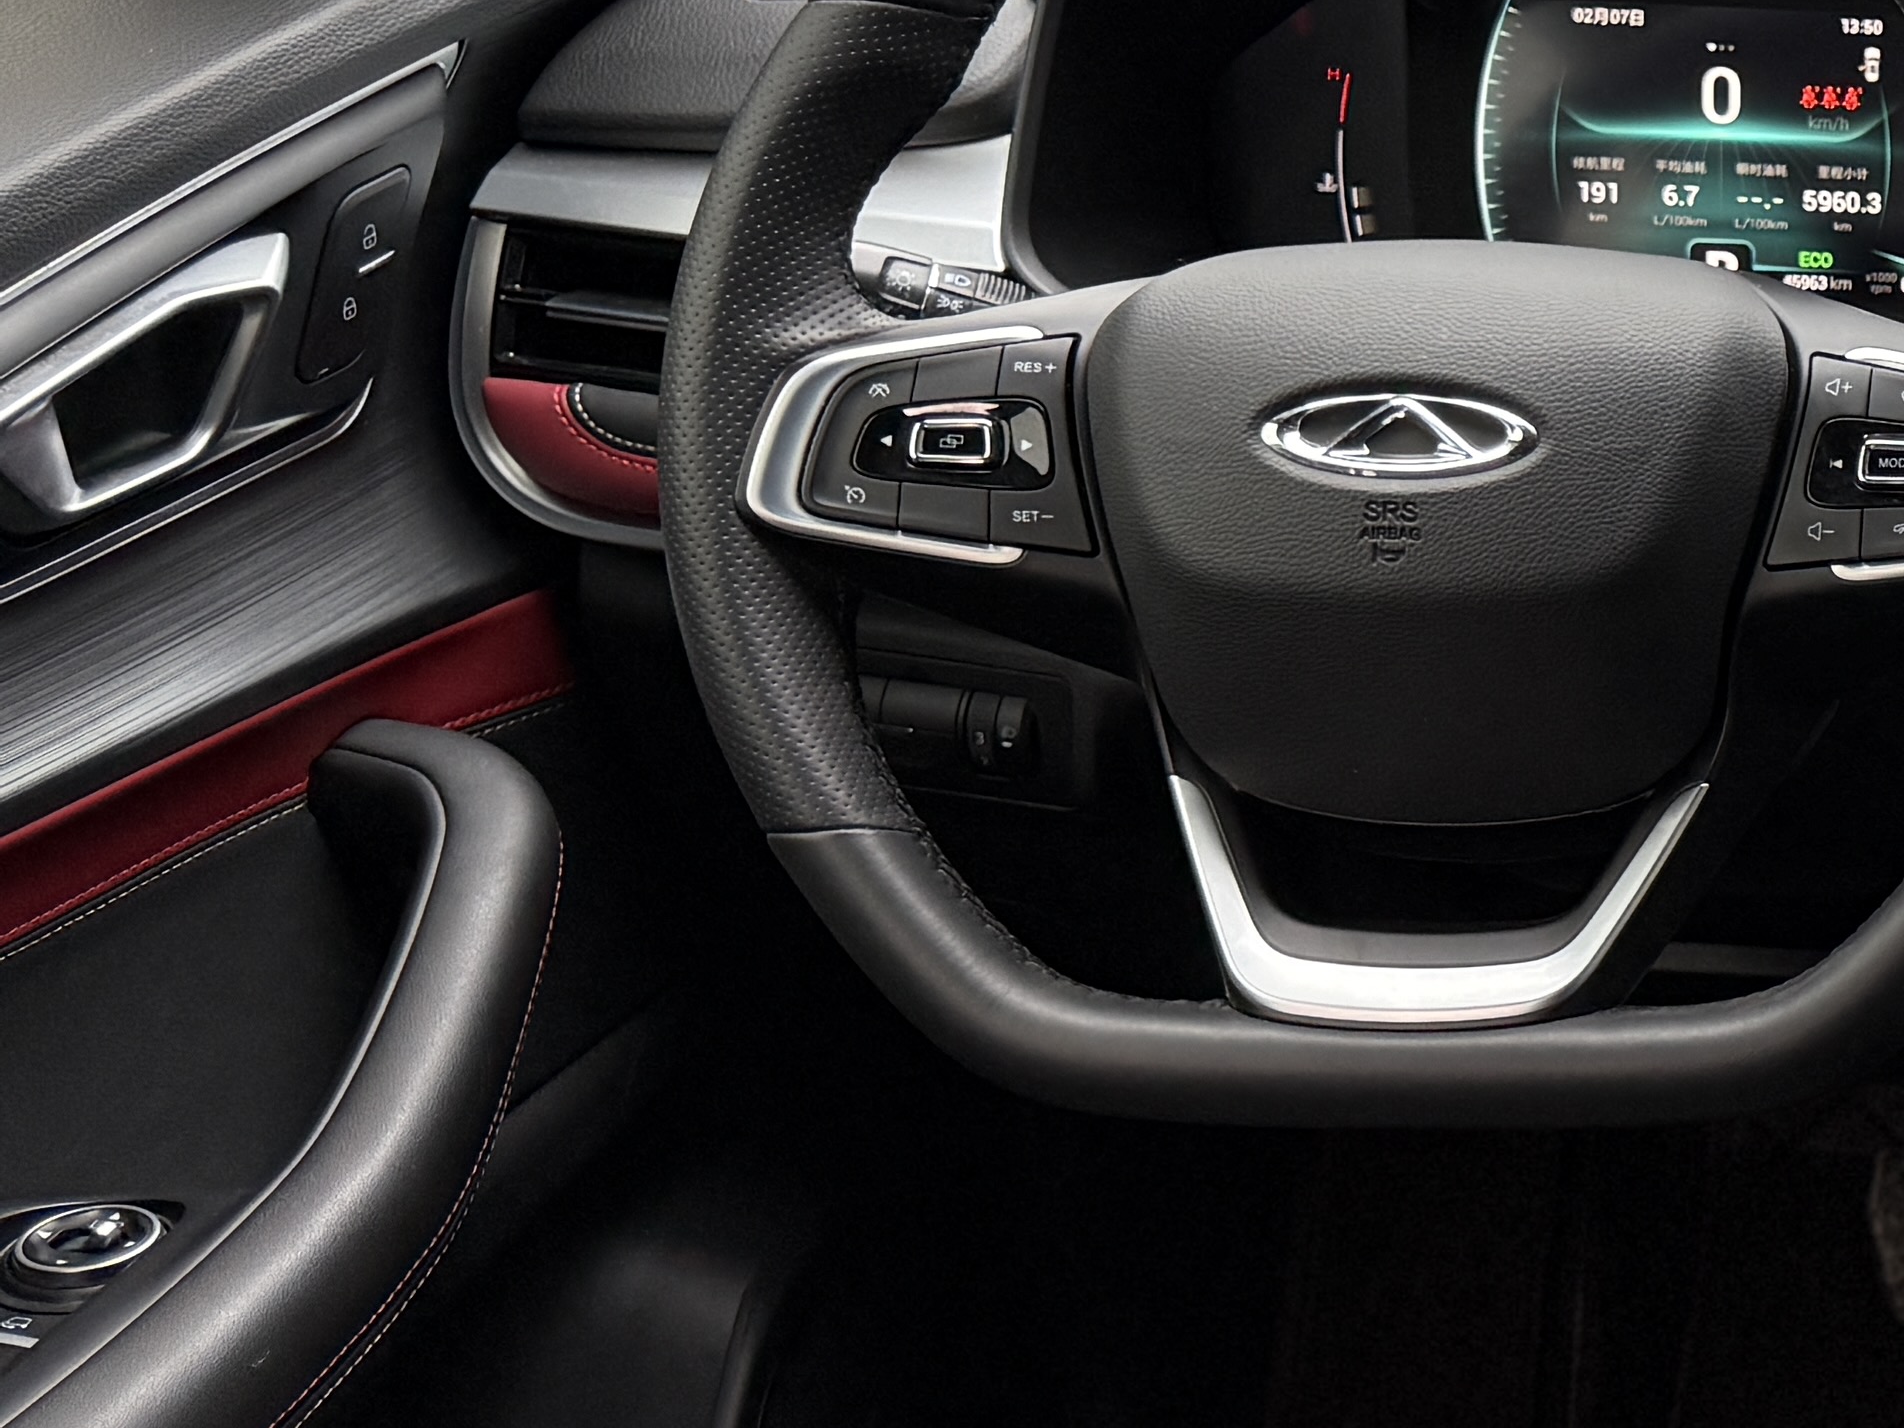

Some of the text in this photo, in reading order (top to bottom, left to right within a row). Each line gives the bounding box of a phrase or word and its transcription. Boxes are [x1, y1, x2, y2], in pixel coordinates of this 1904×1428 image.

[1571, 7, 1645, 27] 02月07日
[1701, 66, 1742, 124] 0
[1808, 115, 1850, 131] km/h
[1577, 181, 1619, 204] 191
[1661, 183, 1700, 207] 6.7
[1802, 188, 1882, 215] 5960.3
[1588, 212, 1609, 223] km
[1653, 215, 1708, 228] L/100km
[1734, 218, 1789, 231] L/100km
[1833, 221, 1853, 232] km
[1798, 251, 1834, 269] ECO
[1829, 275, 1853, 291] km
[1362, 500, 1420, 522] SRS
[1359, 526, 1422, 541] AIRBAG
